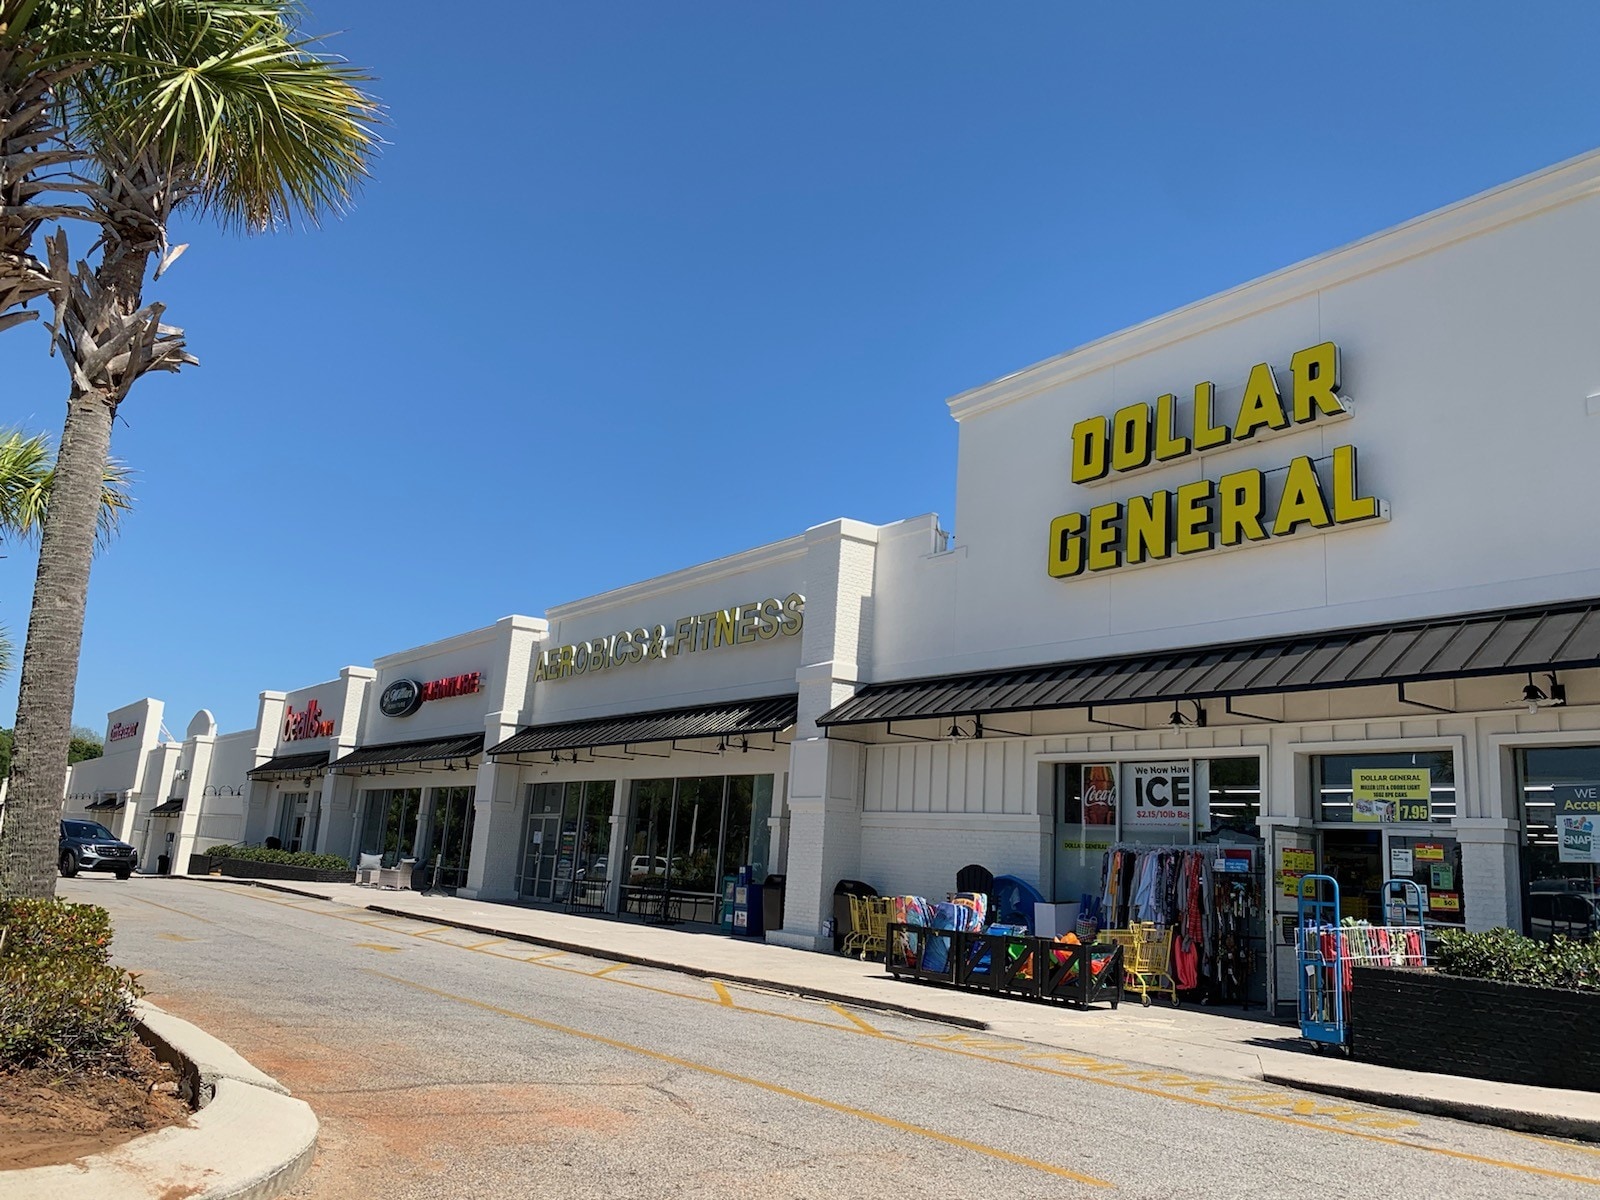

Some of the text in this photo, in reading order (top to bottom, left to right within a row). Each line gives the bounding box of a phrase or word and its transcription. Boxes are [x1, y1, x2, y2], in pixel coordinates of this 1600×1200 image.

[1071, 341, 1346, 484] DOLLAR
[1047, 444, 1378, 579] GENERAL
[533, 592, 806, 683] AEROBICS & FITNESS
[1135, 766, 1148, 775] We
[1150, 766, 1168, 774] Now
[1135, 776, 1189, 807] ICE
[1574, 787, 1597, 799] WE
[1564, 834, 1591, 845] SNAP
